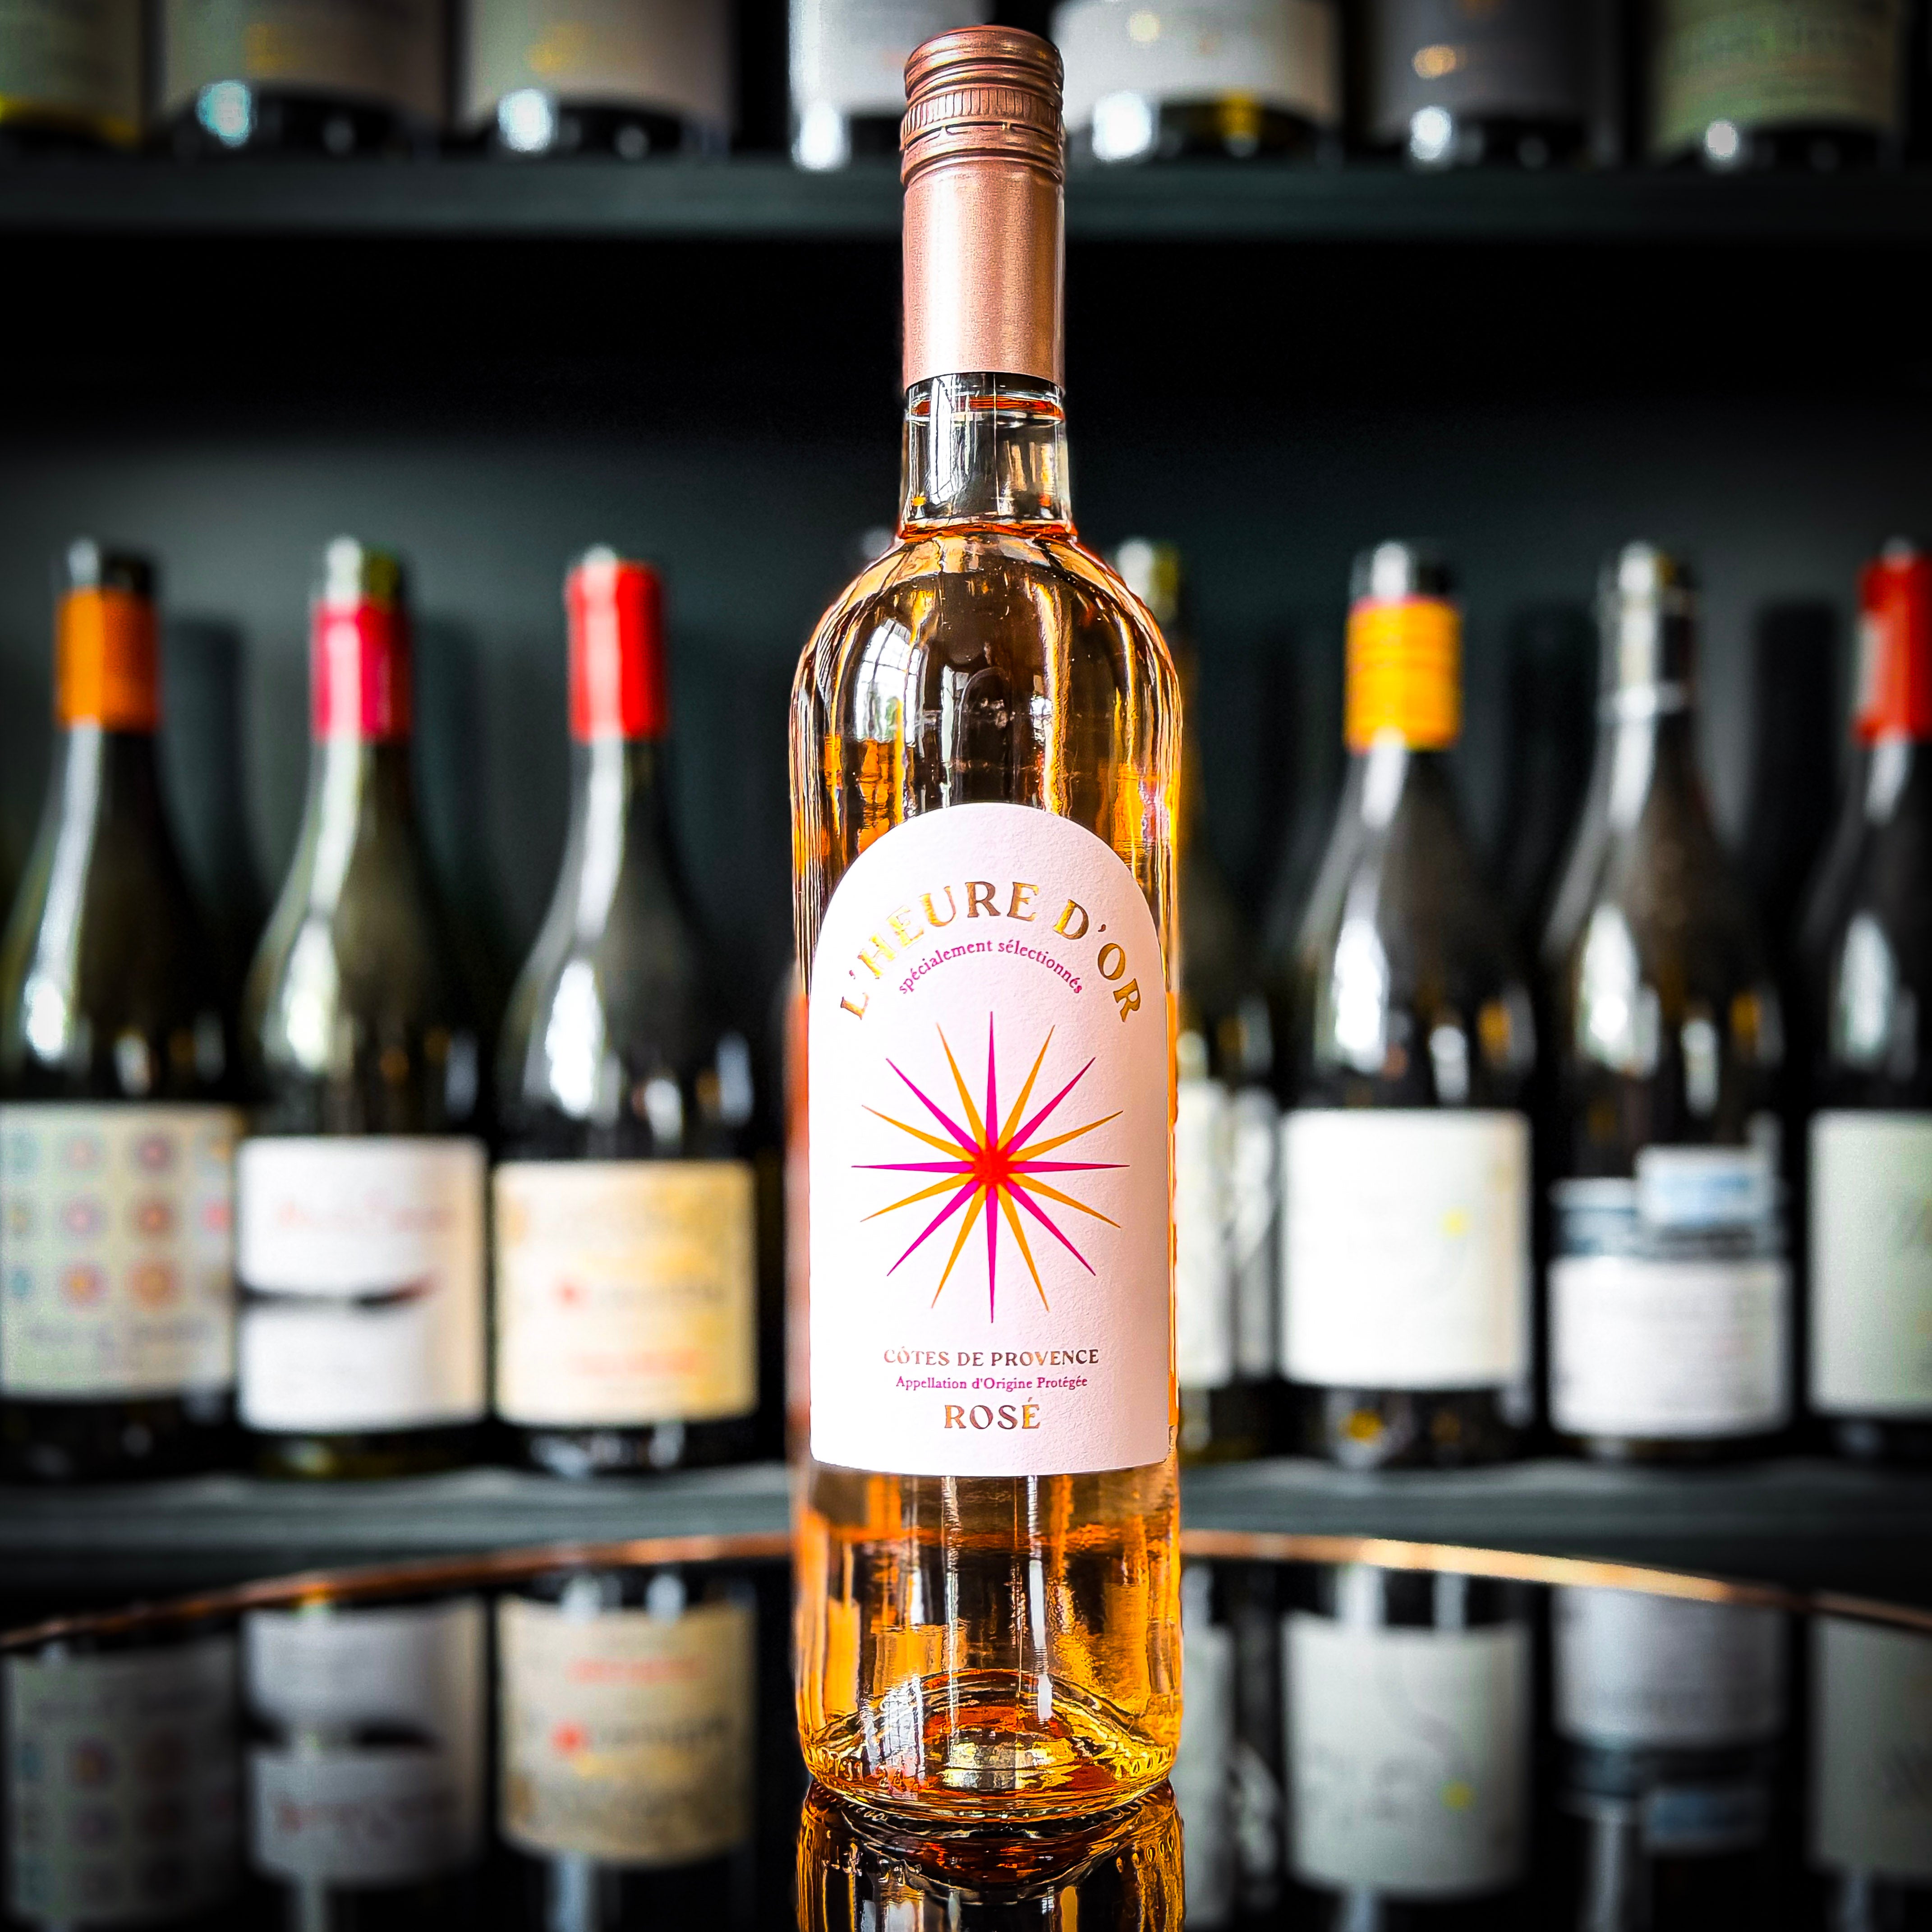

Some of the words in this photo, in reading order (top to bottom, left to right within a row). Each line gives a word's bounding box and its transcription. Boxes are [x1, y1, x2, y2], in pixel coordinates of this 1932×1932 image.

[840, 881, 1039, 1020] L'HEURE
[1053, 899, 1141, 1022] D'OR
[899, 939, 993, 994] spécialement
[998, 939, 1083, 994] sélectionnés
[957, 1352, 984, 1366] DE
[991, 1349, 1099, 1366] PROVENCE
[896, 1376, 967, 1391] Appellation
[971, 1378, 1033, 1392] d'Origine
[1036, 1375, 1088, 1390] Protégée
[944, 1397, 1041, 1430] ROSÉ
